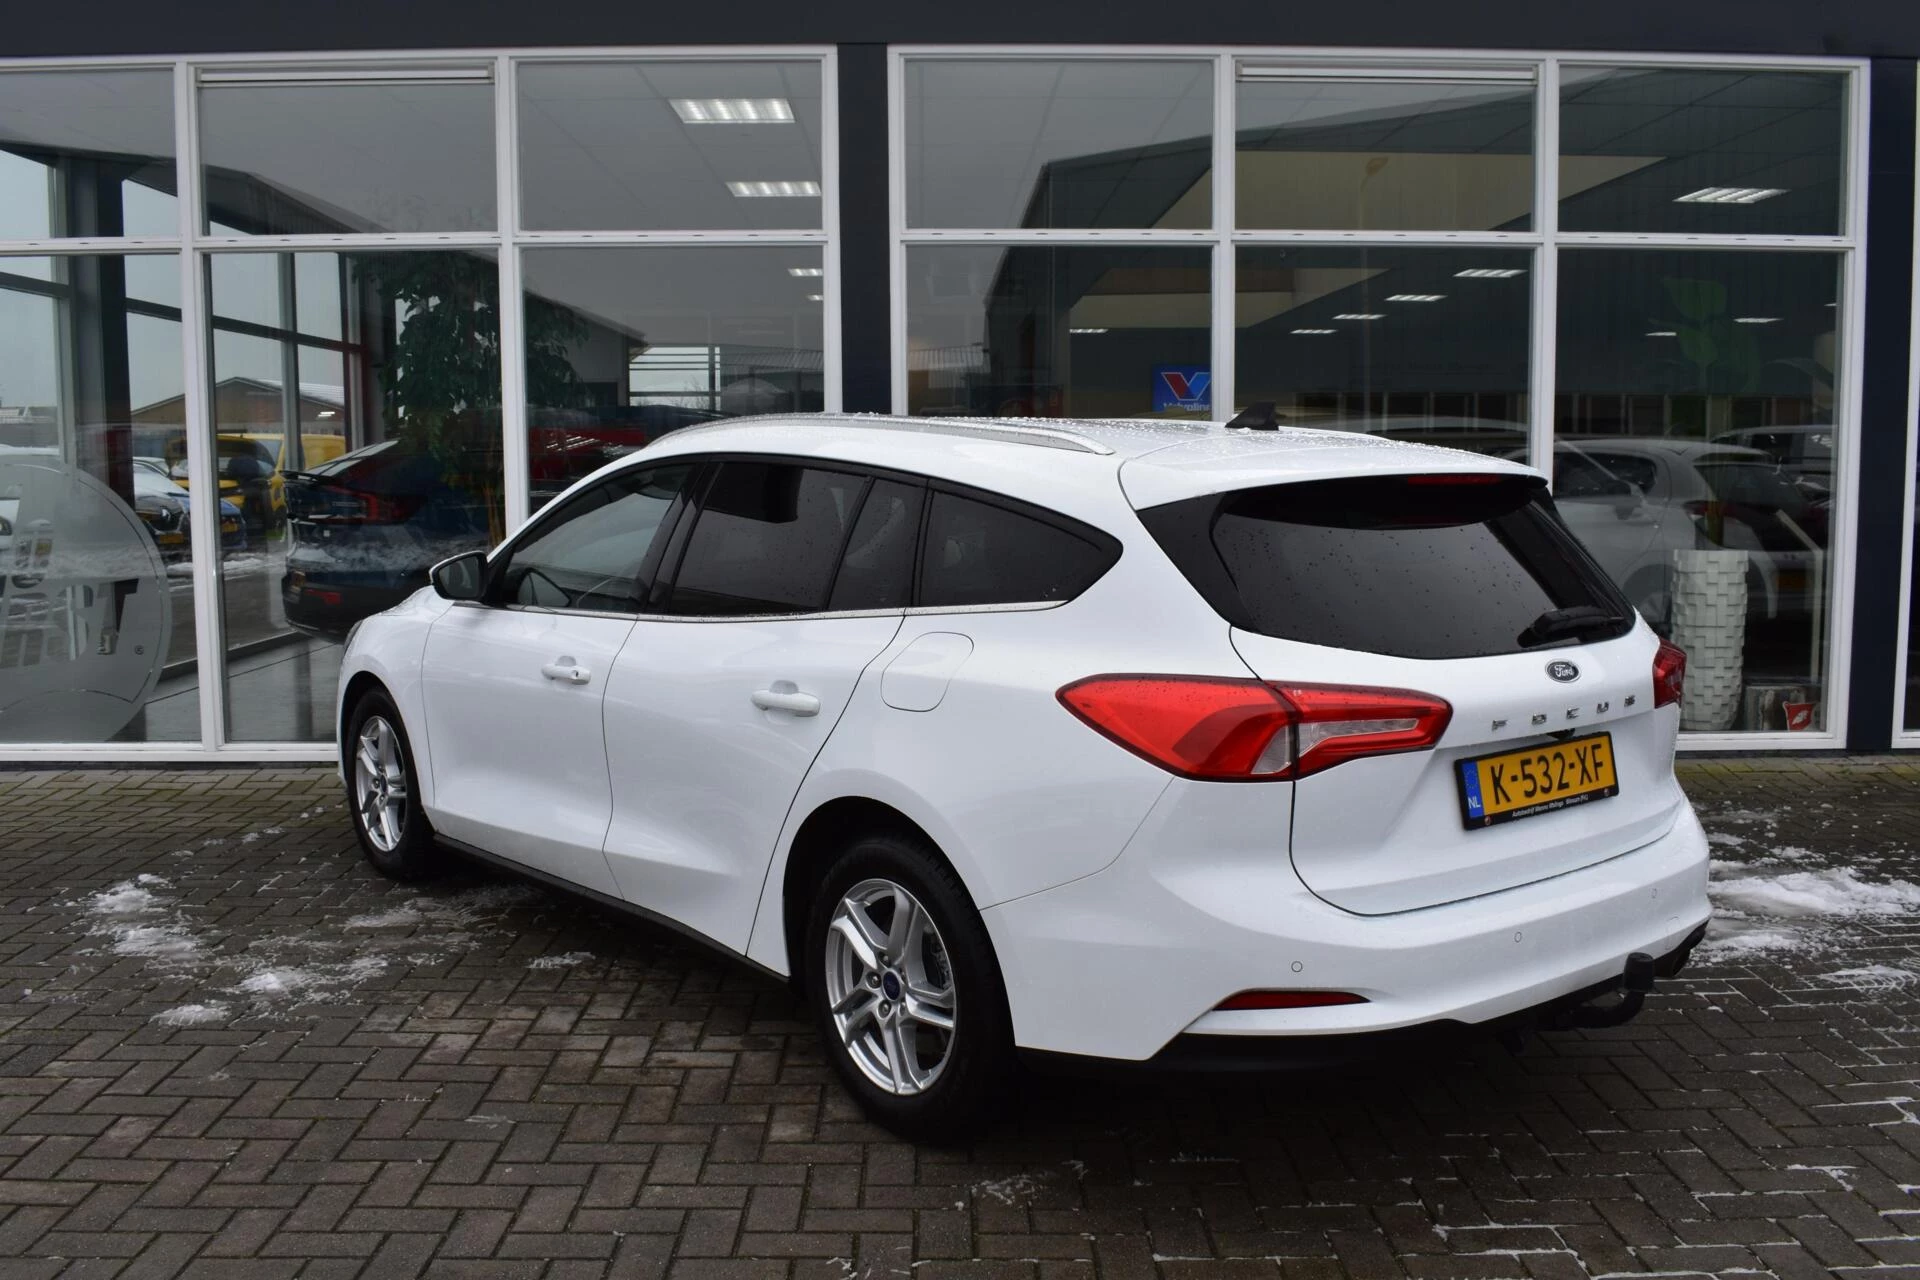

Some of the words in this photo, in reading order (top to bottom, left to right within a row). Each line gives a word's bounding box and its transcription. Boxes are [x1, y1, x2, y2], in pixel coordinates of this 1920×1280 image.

[1491, 694, 1636, 731] FOCUS
[1490, 743, 1604, 805] K-532-XF
[1468, 797, 1481, 809] NL
